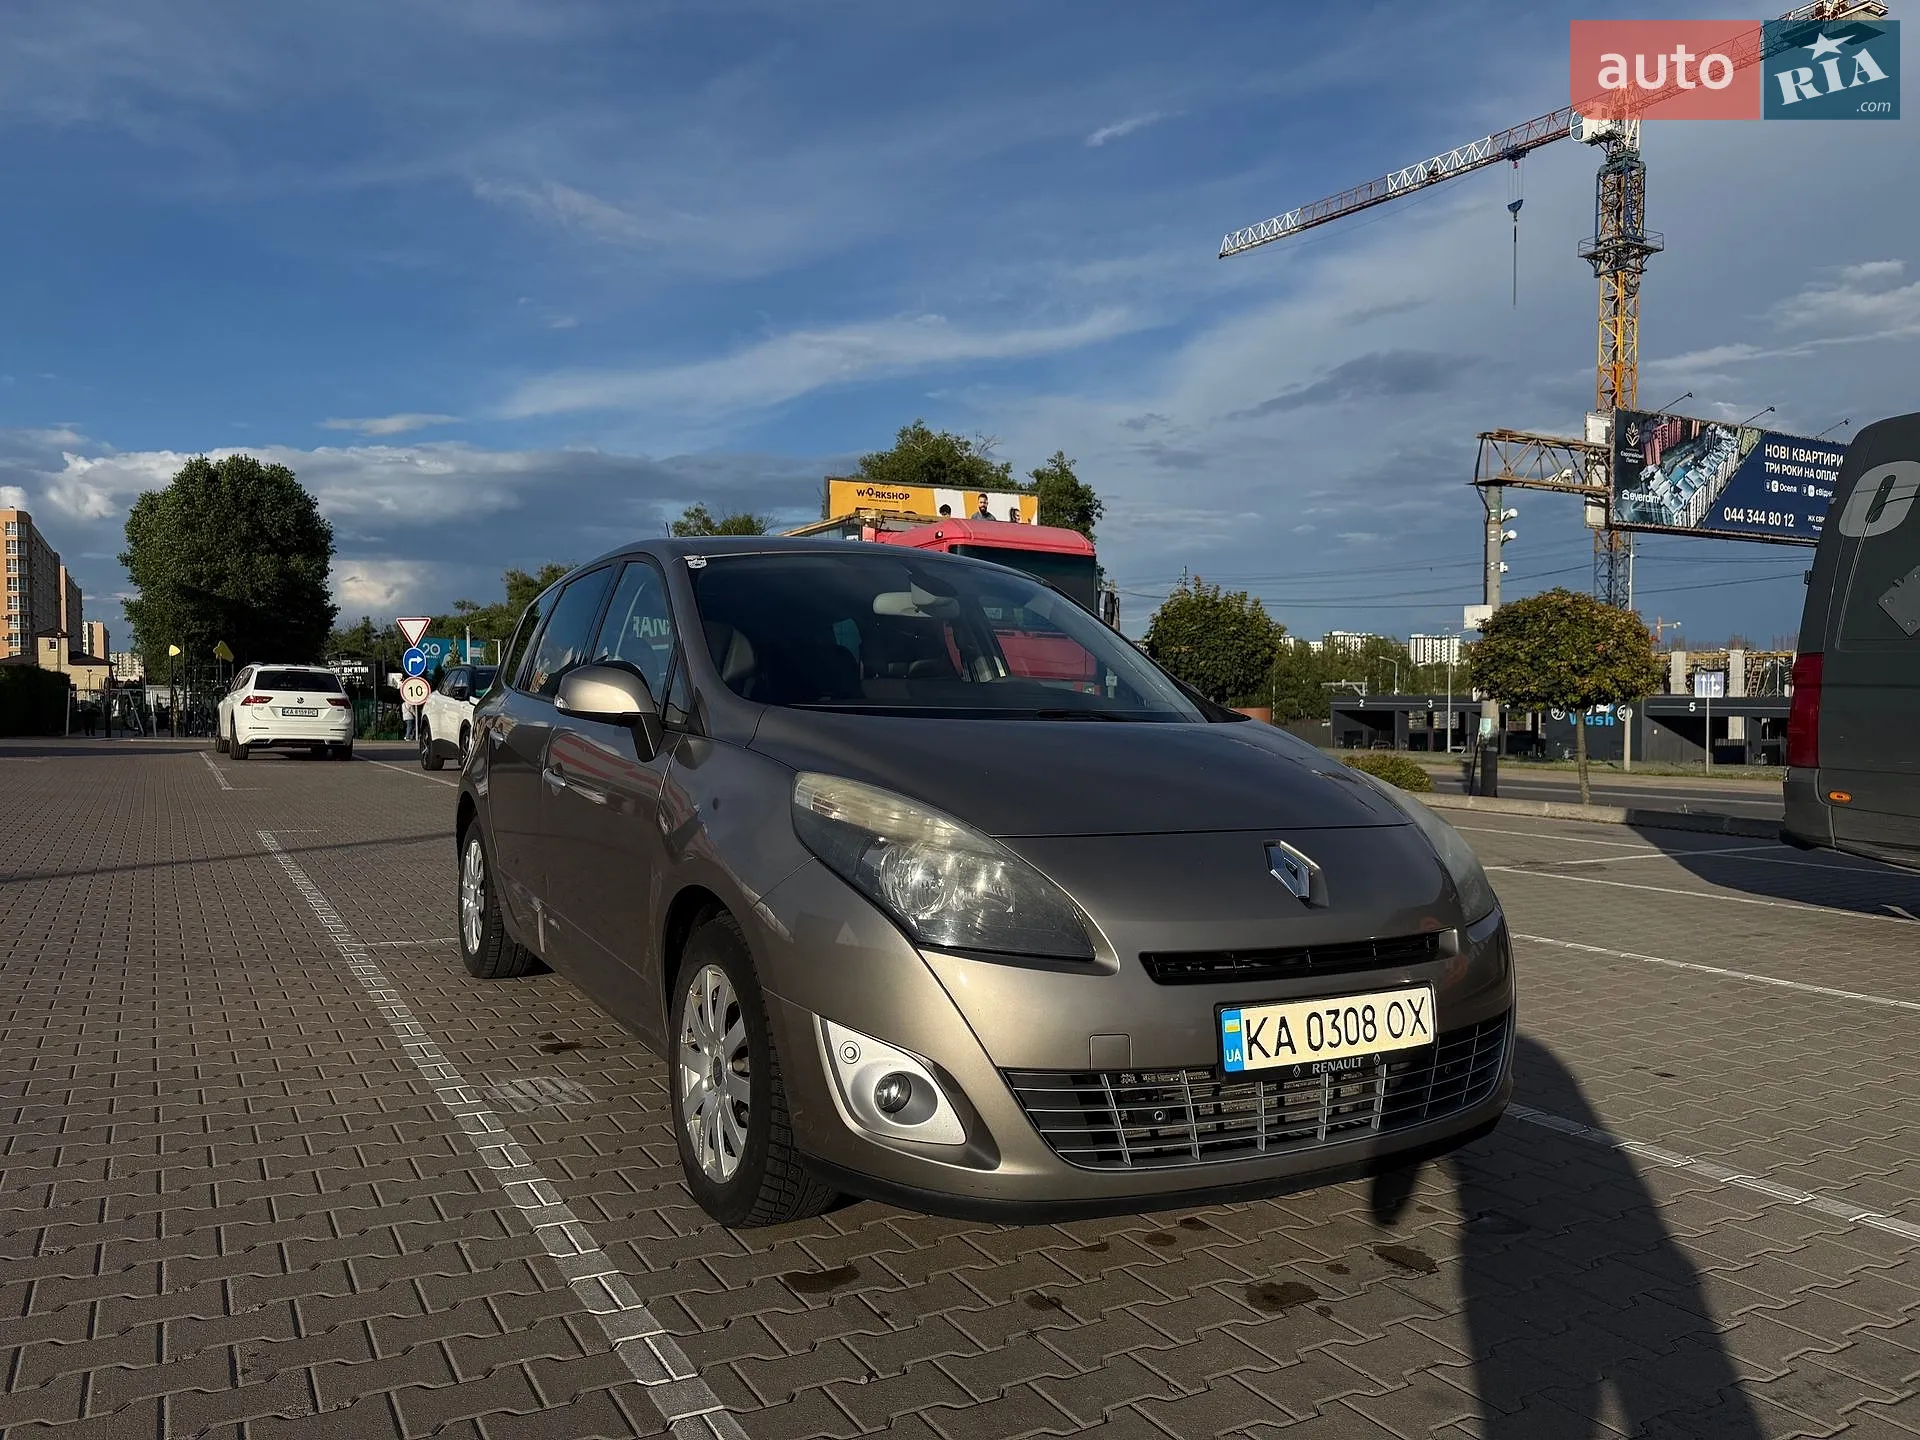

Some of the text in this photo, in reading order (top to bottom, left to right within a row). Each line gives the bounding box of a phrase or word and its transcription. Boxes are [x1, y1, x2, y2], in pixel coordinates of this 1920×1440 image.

[1765, 443, 1844, 467] НОВІ КВАРТИРИ
[1764, 461, 1780, 475] ТРИ
[1782, 464, 1803, 477] РОКИ
[1804, 467, 1815, 479] НА
[856, 487, 910, 500] WORKSHOP
[1724, 507, 1744, 523] 044
[1746, 509, 1766, 525] 344
[1768, 511, 1781, 527] 80
[1783, 513, 1795, 528] 12
[408, 685, 423, 697] 10
[1359, 699, 1364, 708] 2
[1427, 699, 1433, 708] 3
[1688, 702, 1696, 712] 5
[1246, 996, 1428, 1061] KA 0308 OX
[1226, 1048, 1242, 1063] UA
[1312, 1056, 1363, 1075] RENAULT
